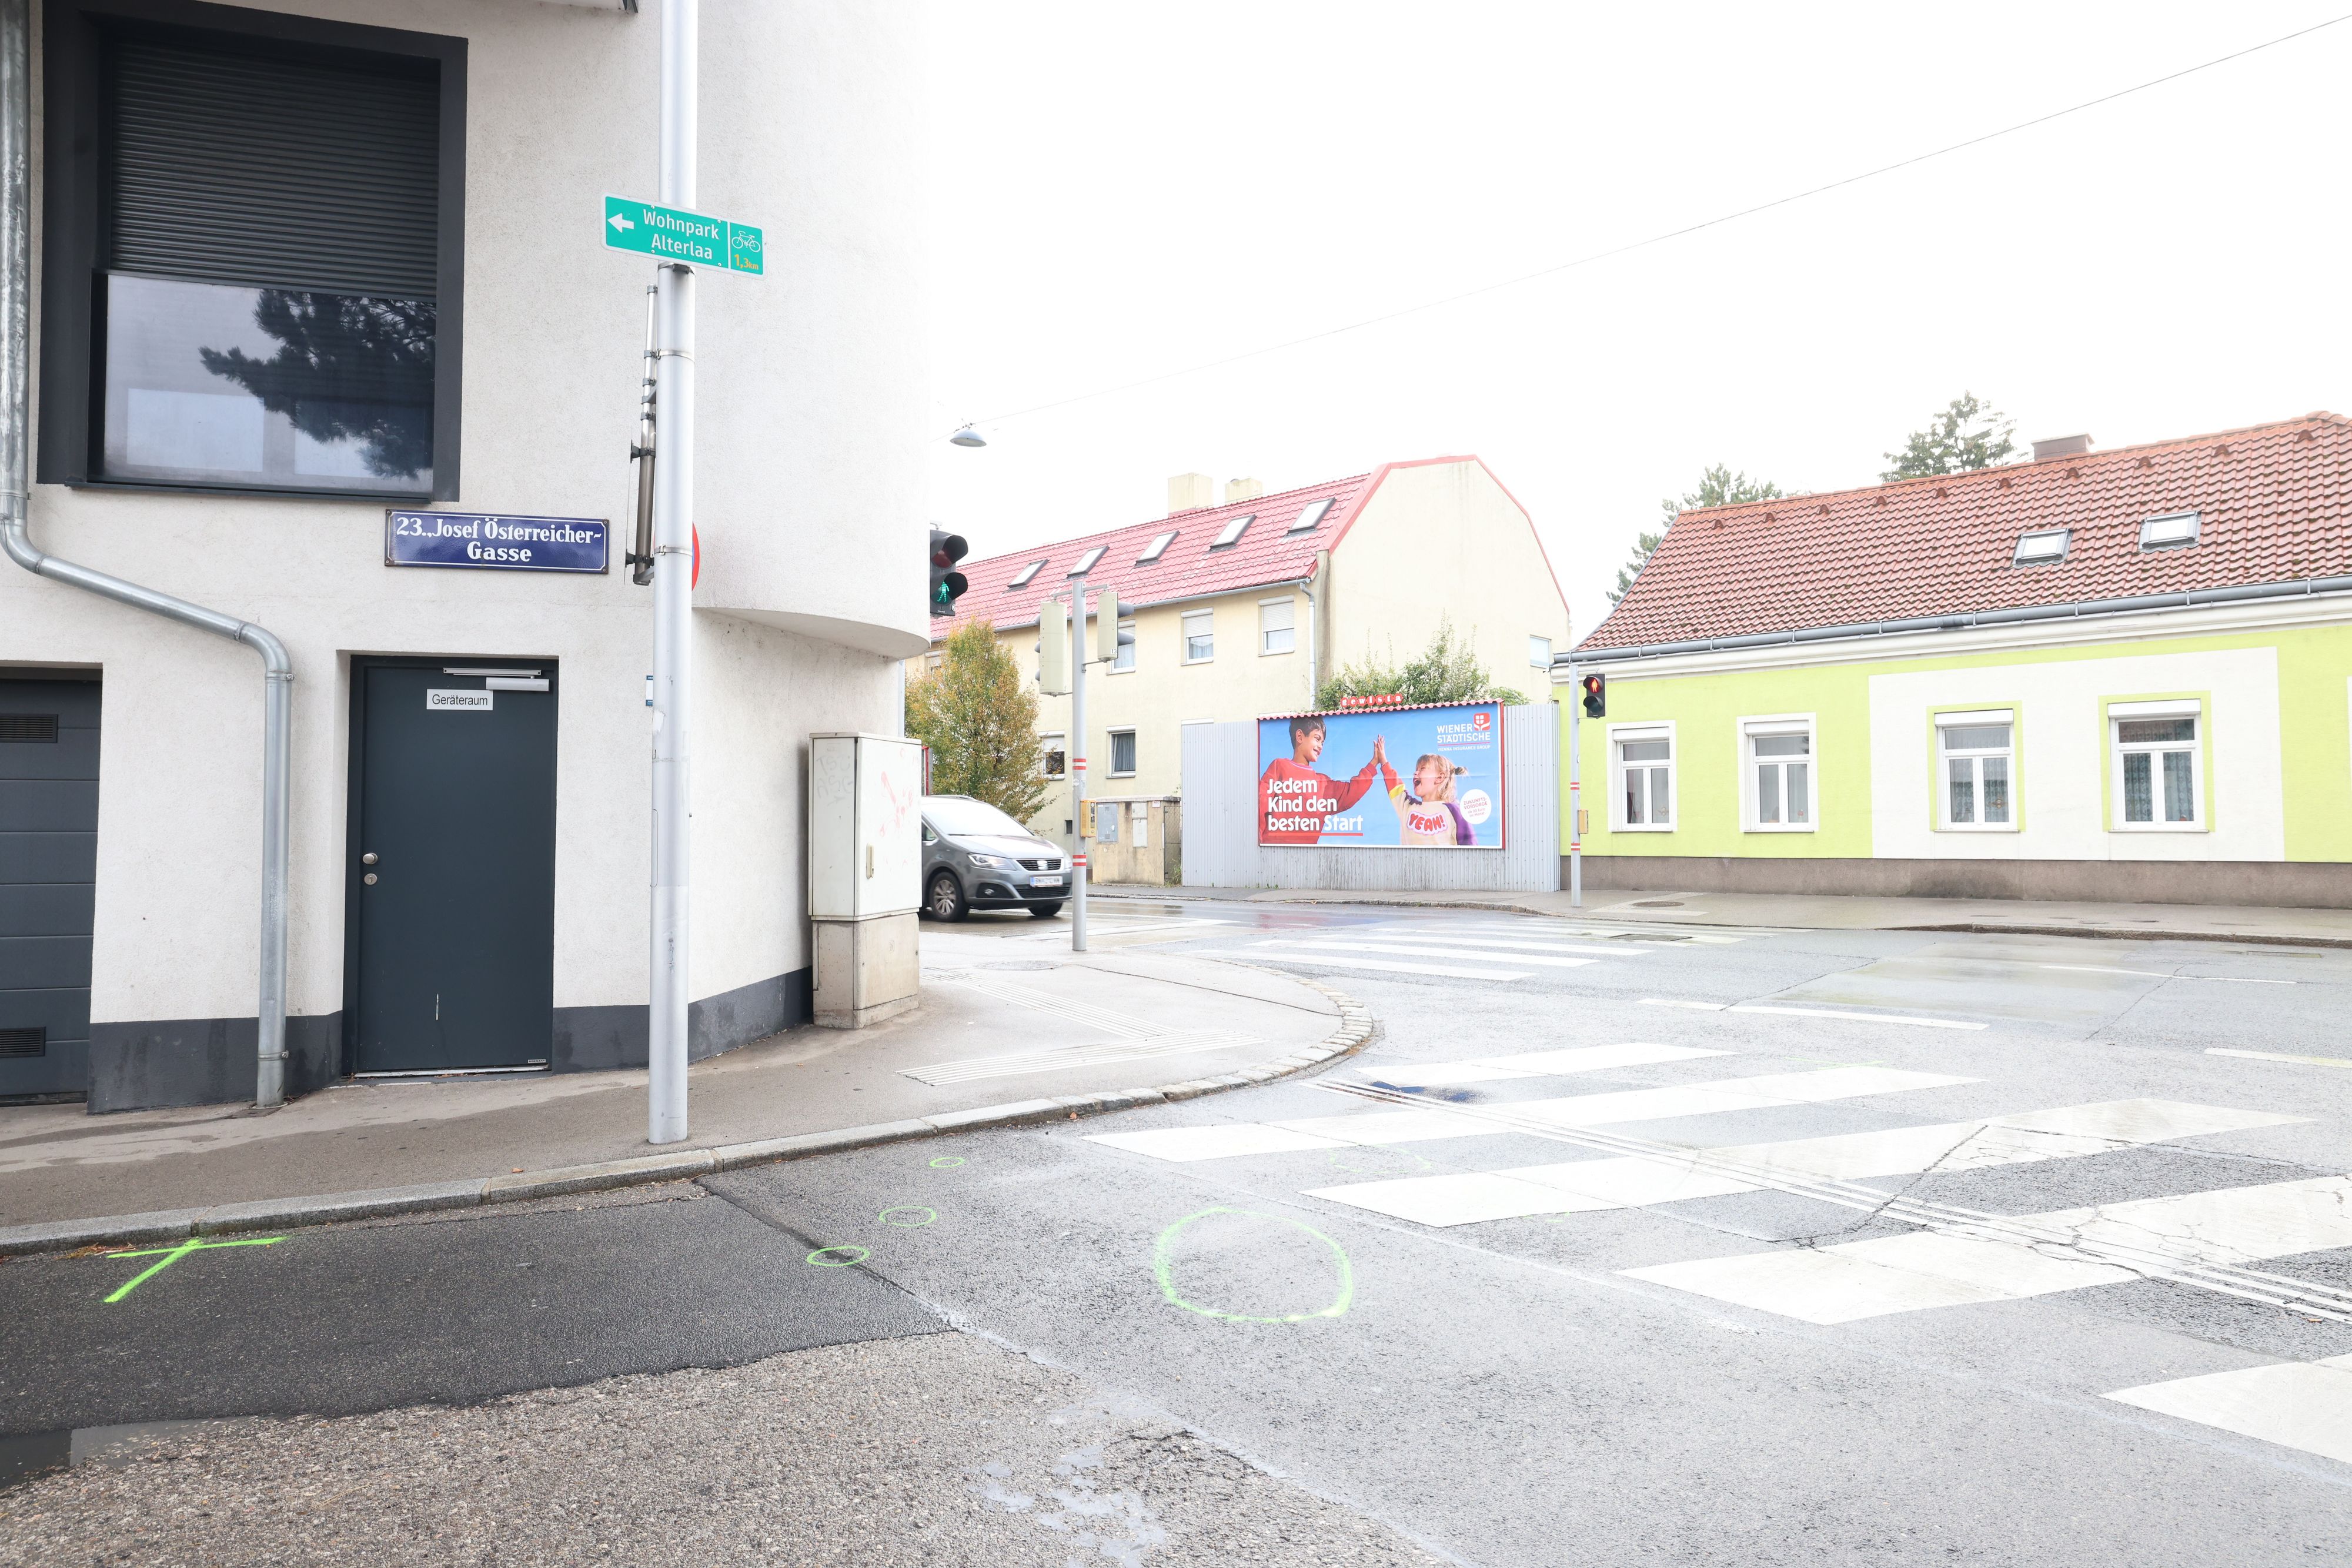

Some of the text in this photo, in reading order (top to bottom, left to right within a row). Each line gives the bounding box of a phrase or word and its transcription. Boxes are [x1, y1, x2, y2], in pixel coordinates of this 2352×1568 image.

[643, 209, 719, 240] Wohnpark
[651, 233, 713, 260] Alterlaa
[485, 518, 602, 544] Österreicher-
[467, 541, 532, 562] Gasse
[432, 694, 488, 705] Geräteraum
[1342, 694, 1402, 706] gewista
[1436, 724, 1473, 734] WIENER
[1436, 732, 1491, 743] STÄDTISCHE
[1267, 778, 1318, 794] Jedem
[1268, 795, 1337, 813] Kind den
[1464, 797, 1487, 805] ZUKUNFTS-
[1464, 801, 1488, 810] VORSORGE
[1268, 814, 1364, 831] besten Start
[1409, 813, 1445, 832] YEAH!
